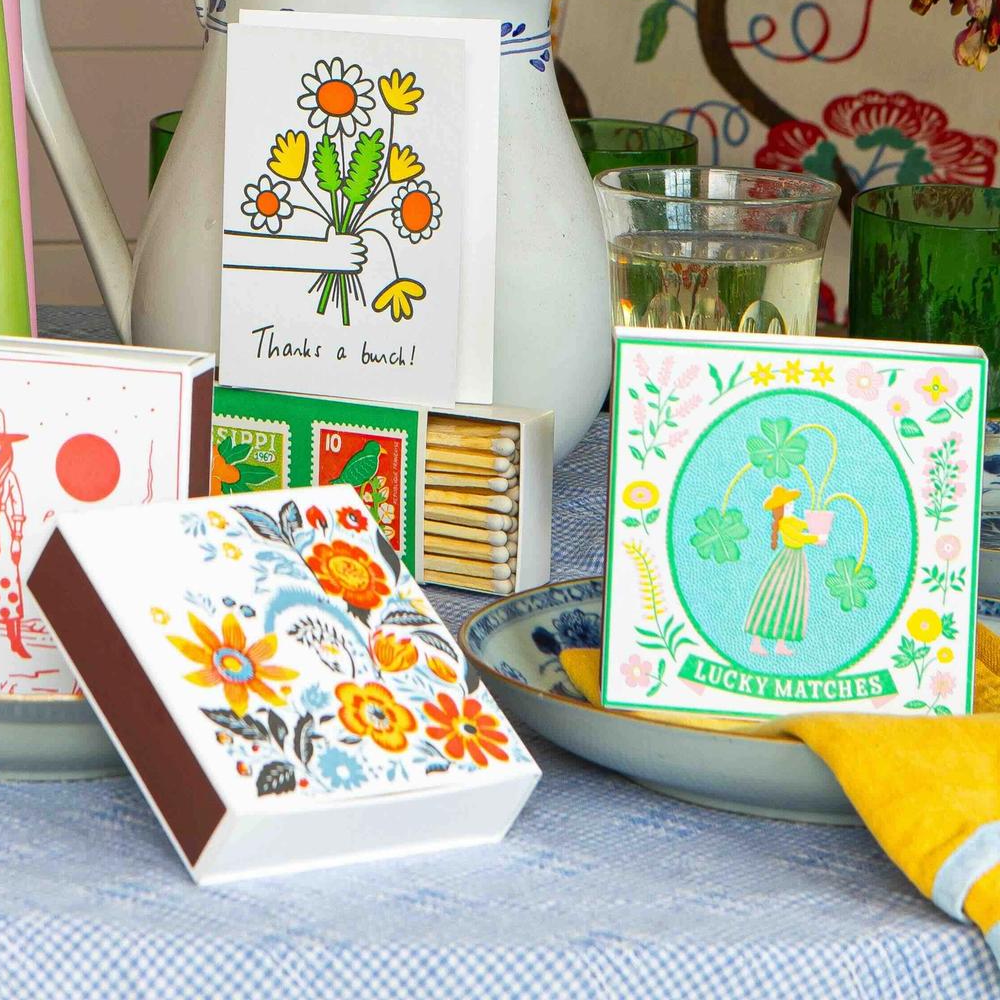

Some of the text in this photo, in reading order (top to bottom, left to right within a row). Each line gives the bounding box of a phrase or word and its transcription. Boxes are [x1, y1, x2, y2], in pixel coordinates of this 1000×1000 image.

[252, 325, 416, 367] Thanks a bunch!
[325, 433, 342, 453] 10
[693, 659, 884, 700] LUCKY MATCHES
